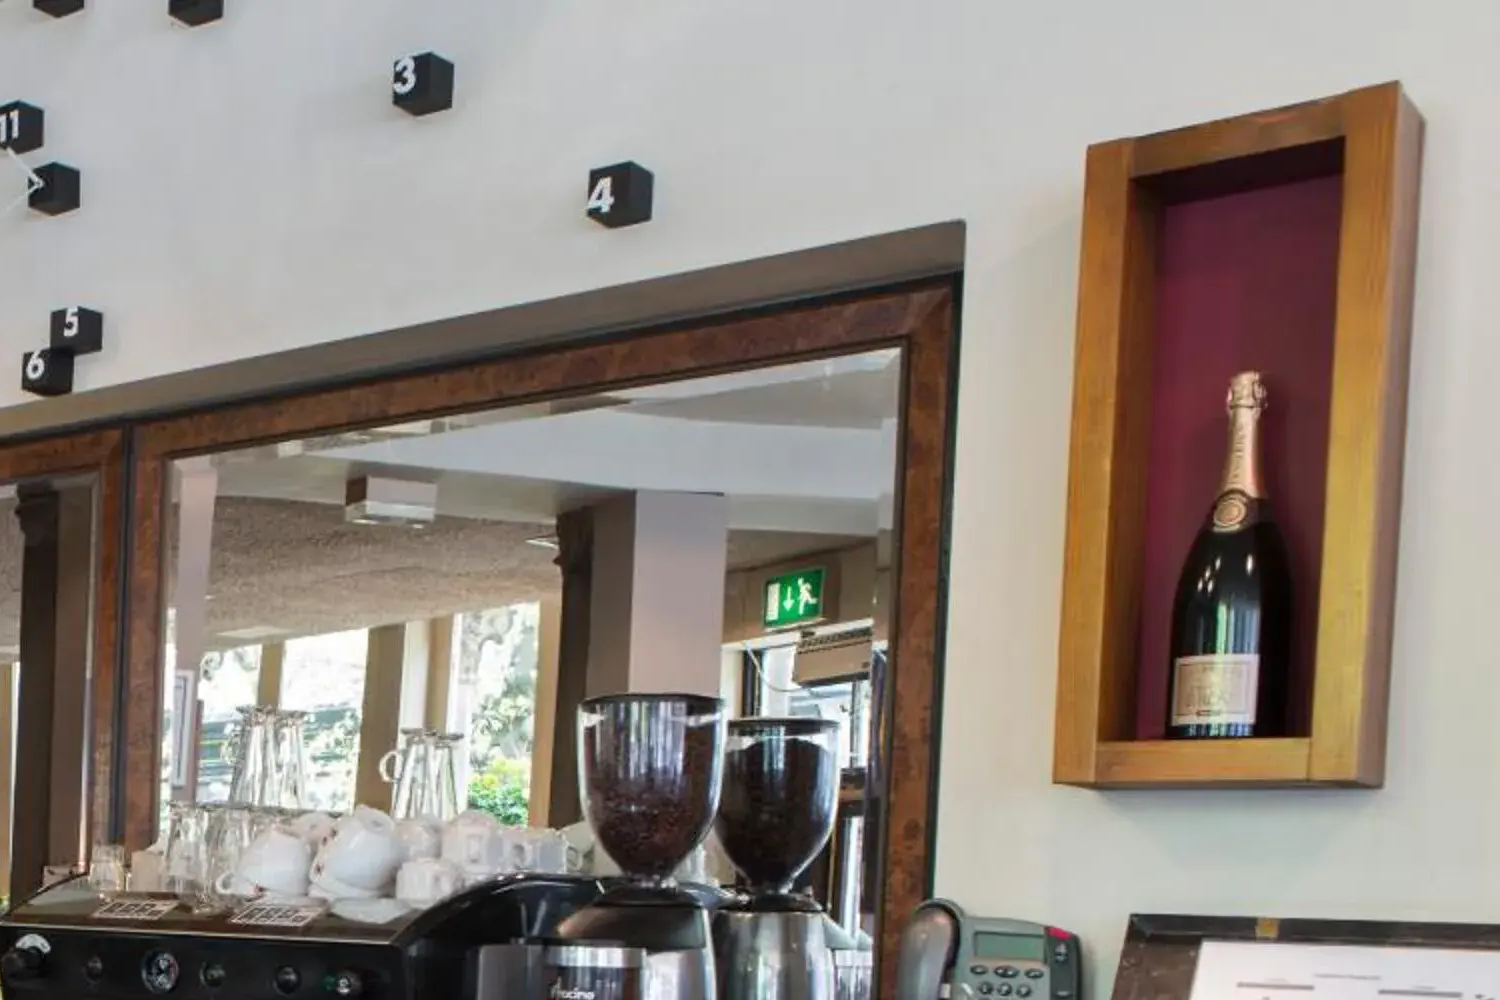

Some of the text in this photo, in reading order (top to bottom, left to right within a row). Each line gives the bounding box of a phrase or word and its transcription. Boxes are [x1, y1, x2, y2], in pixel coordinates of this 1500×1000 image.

[393, 57, 416, 94] 3
[587, 176, 615, 213] 4
[63, 308, 79, 337] 5
[26, 350, 45, 380] 6
